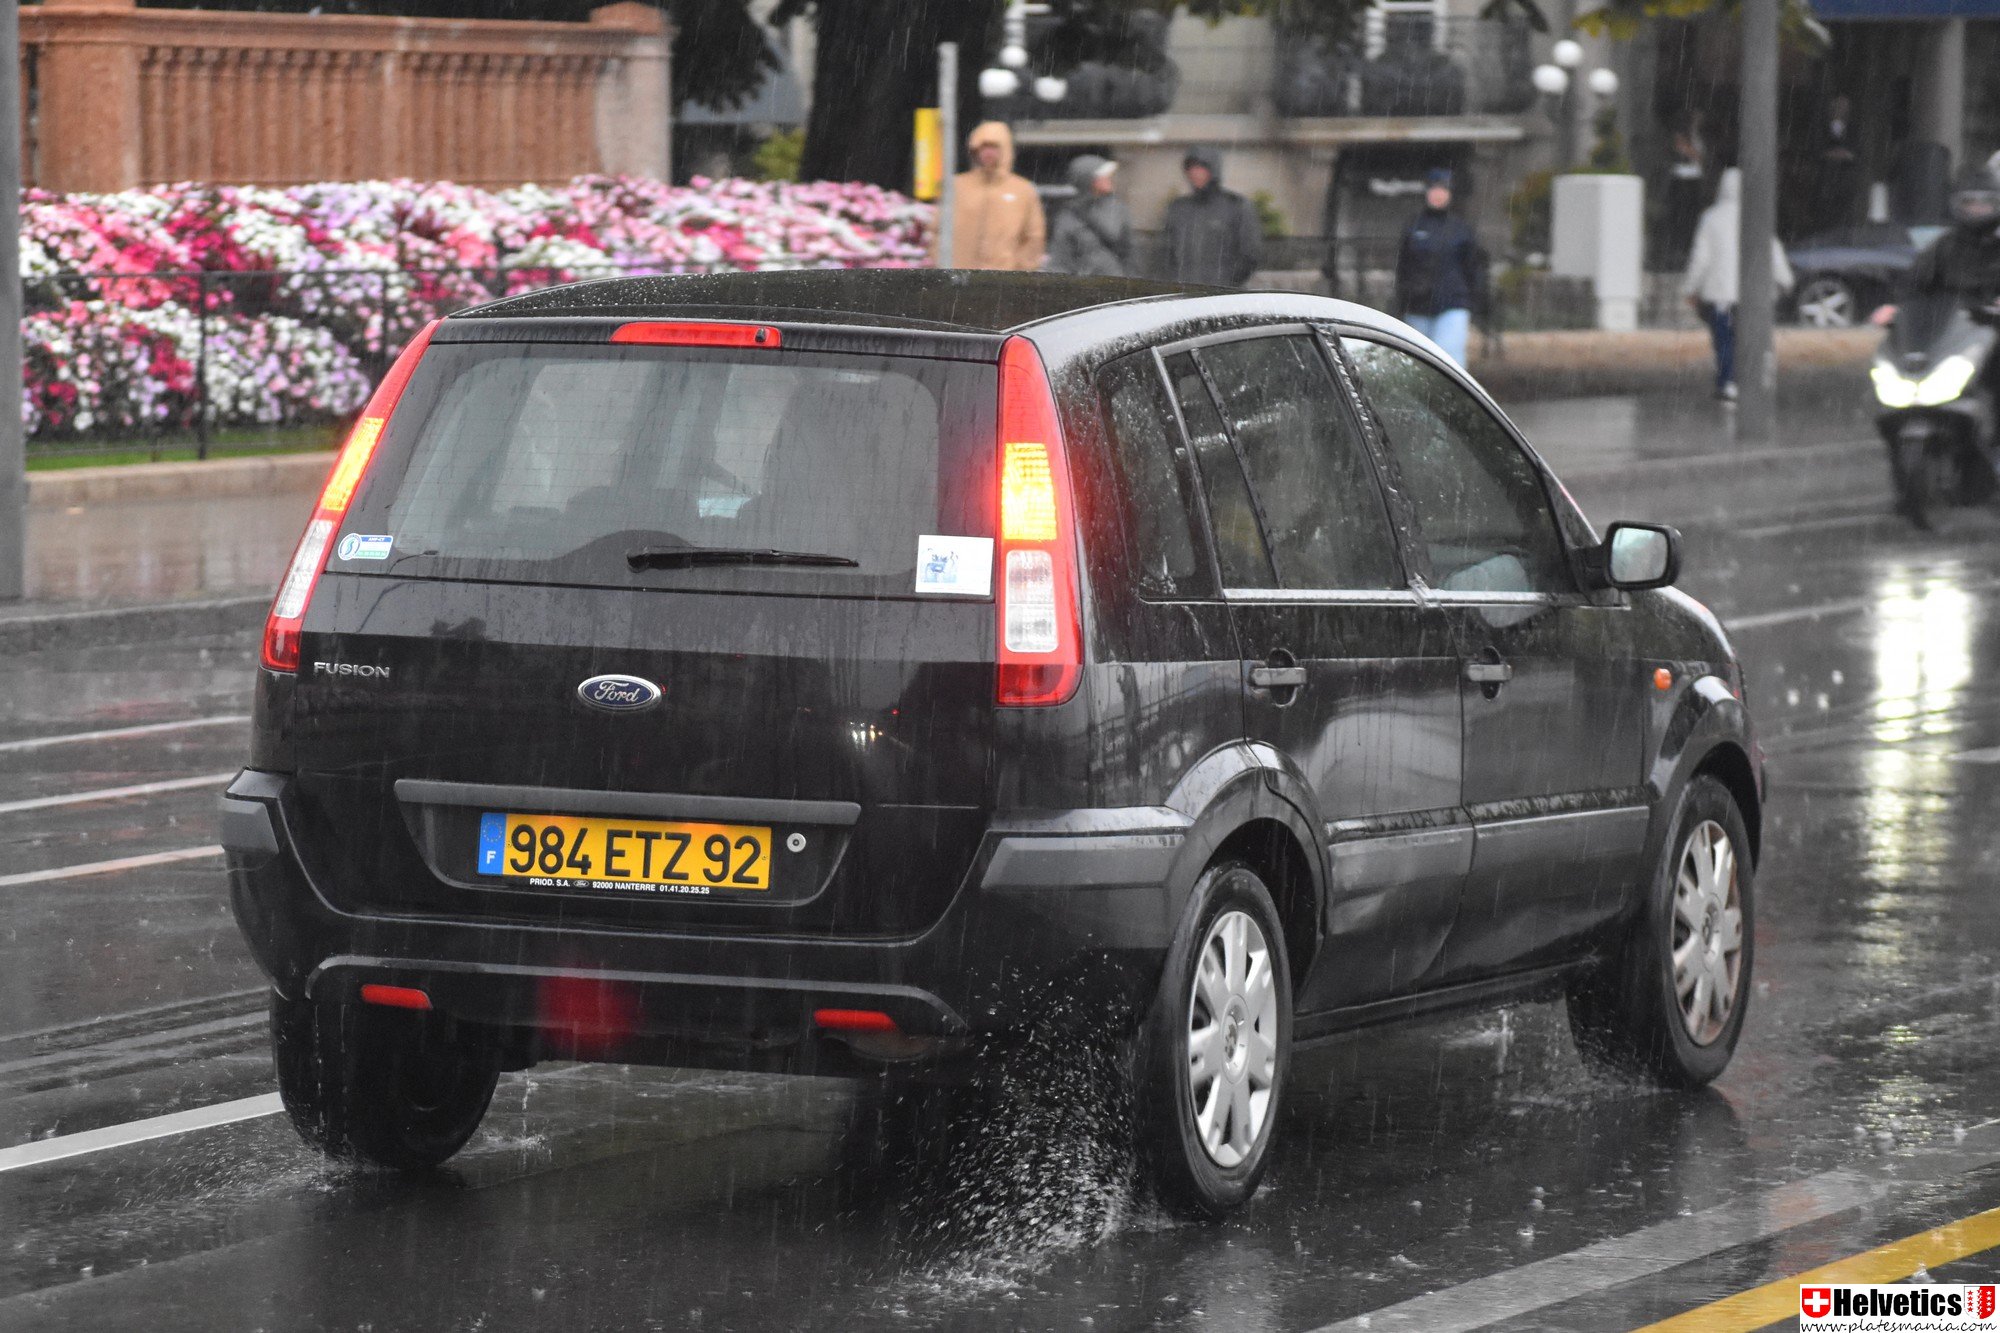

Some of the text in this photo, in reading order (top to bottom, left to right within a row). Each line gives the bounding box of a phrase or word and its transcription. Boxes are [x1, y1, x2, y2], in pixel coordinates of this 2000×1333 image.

[313, 661, 390, 678] FUSION
[594, 680, 640, 702] Ford
[486, 850, 496, 864] F
[510, 824, 762, 884] 984 ETZ 92
[529, 877, 555, 886] PRIOD.
[556, 879, 571, 887] S.A.
[592, 881, 613, 889] 92000
[615, 882, 656, 891] NANTERRE
[659, 885, 710, 895] 01.41.20.25.25
